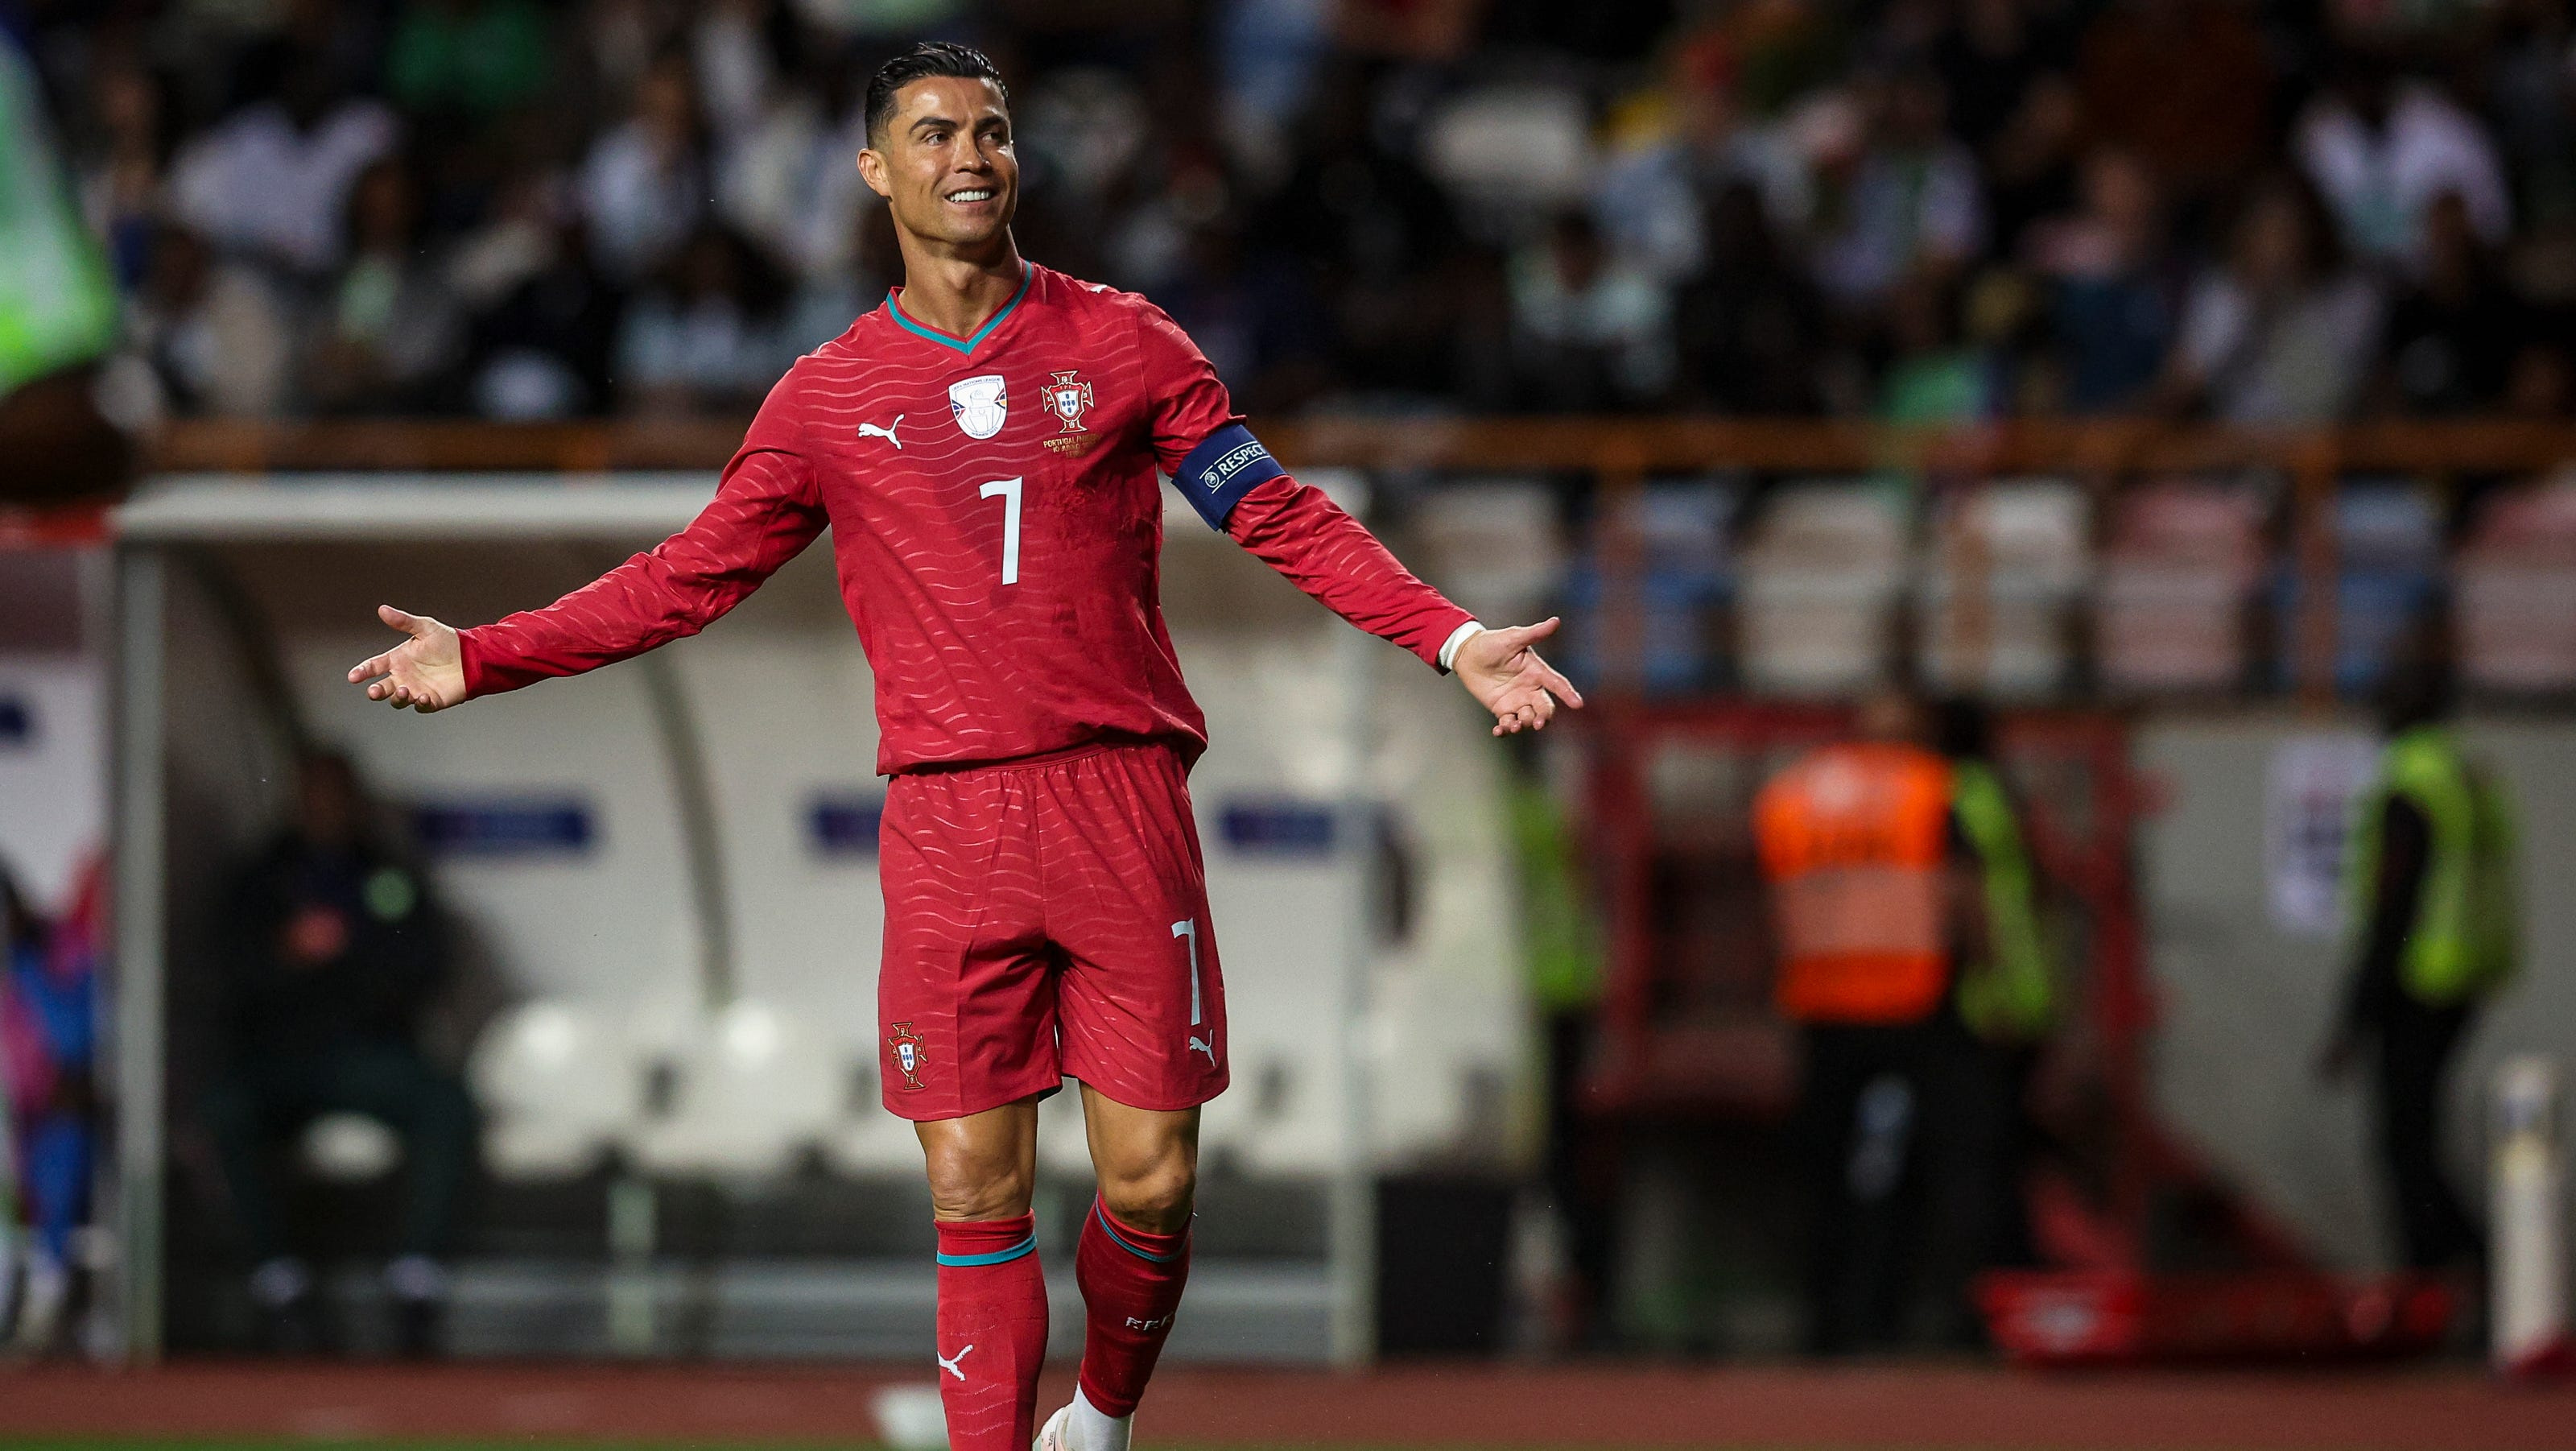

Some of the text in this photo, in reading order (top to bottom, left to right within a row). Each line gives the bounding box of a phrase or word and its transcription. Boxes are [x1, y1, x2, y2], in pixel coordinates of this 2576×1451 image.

[1218, 444, 1266, 476] RESPECT
[979, 476, 1023, 585] 7
[1171, 917, 1201, 1027] 7
